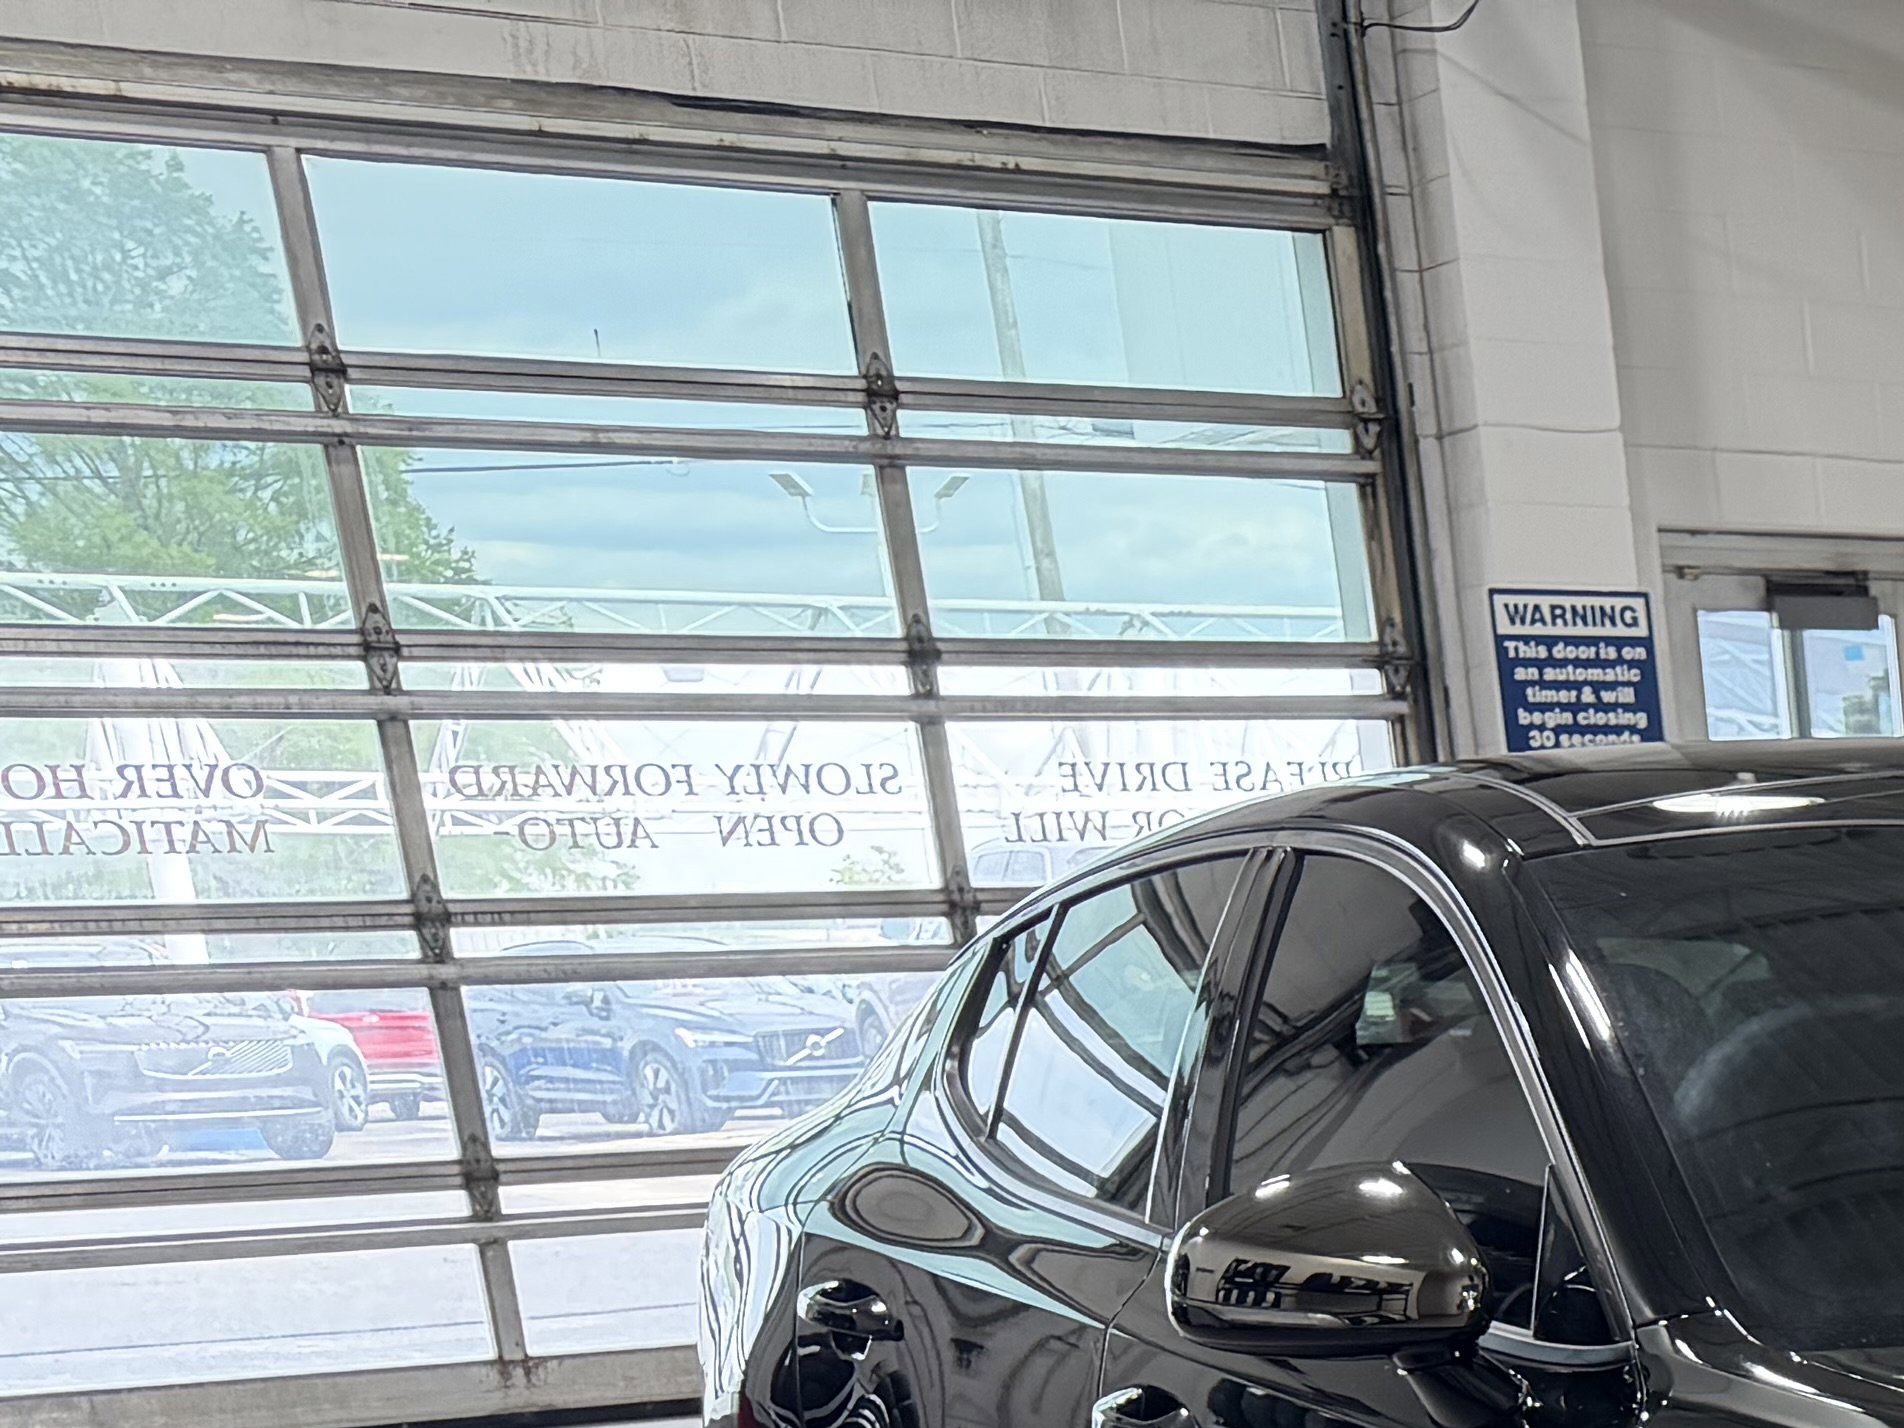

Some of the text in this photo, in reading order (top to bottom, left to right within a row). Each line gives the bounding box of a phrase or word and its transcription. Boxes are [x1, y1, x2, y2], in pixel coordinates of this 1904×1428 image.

[1503, 602, 1640, 628] WARNING
[1502, 640, 1648, 660] This door is on
[1513, 664, 1642, 682] an automatic
[1525, 685, 1636, 704] timer & will
[1517, 707, 1649, 729] begin closing
[1528, 729, 1642, 748] 30 seconds
